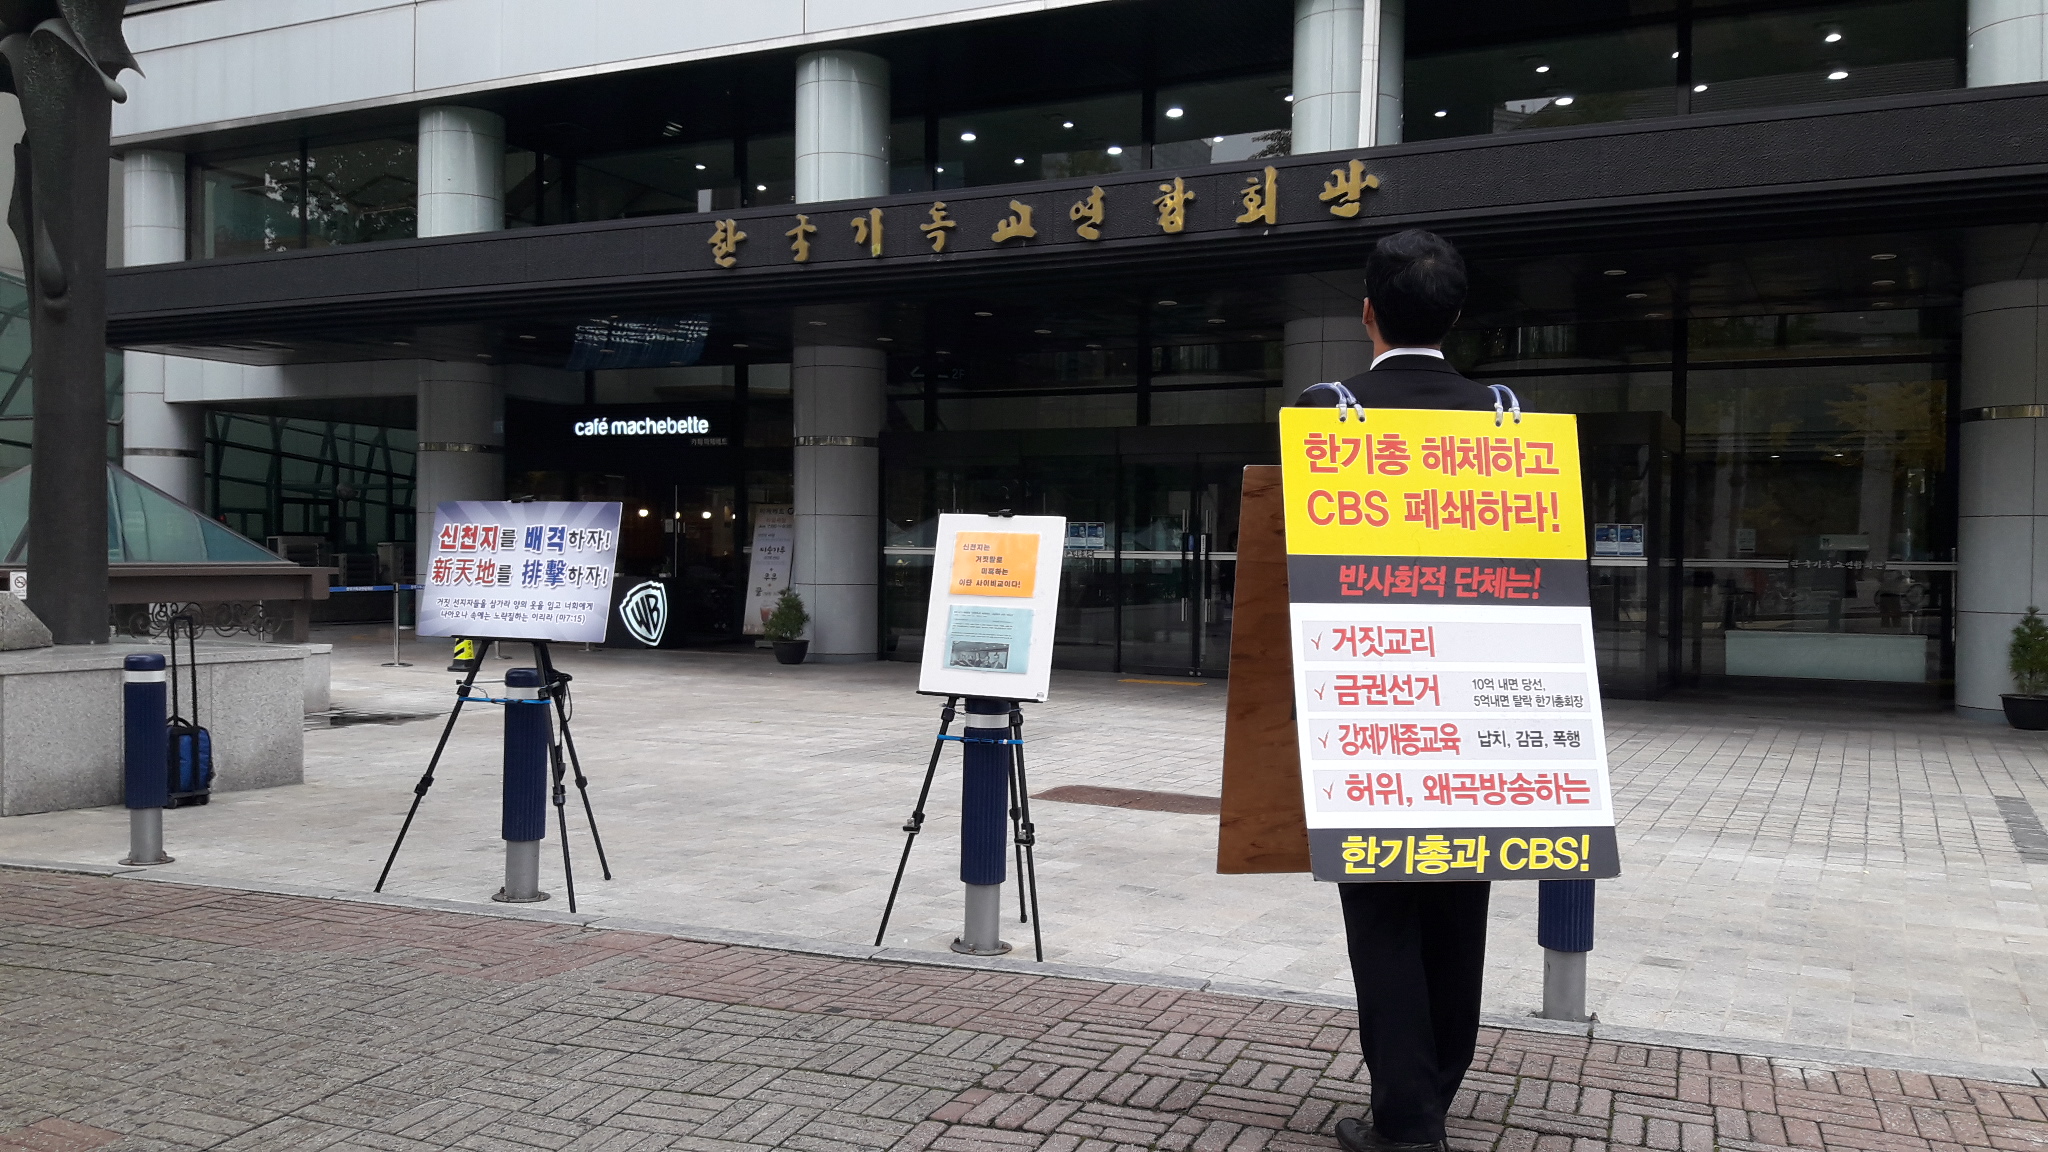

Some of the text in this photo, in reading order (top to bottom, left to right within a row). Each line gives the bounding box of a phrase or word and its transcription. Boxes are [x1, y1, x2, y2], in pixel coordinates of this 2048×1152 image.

[707, 158, 1380, 268] 한국기독교연합회관
[574, 416, 709, 436] café machebette
[1304, 433, 1560, 477] 한기총 해체하고
[1307, 489, 1560, 533] CBS 폐쇄하라!
[440, 525, 611, 552] 신천지를 배격하자!
[432, 558, 608, 586] 新天地를 排擊하자!
[976, 580, 1021, 588] 사이비교이다!
[1339, 564, 1541, 600] 반사회적 단체는!
[437, 598, 593, 611] 거짓 선지자들을 삼가라 양의 옷을 입고 너희에게
[441, 610, 586, 624] 나아오나 속에는 노략질하는 이리라 (마7:15)
[1332, 625, 1435, 657] 거짓교리
[1334, 674, 1441, 706] 금권선거
[1472, 678, 1546, 691] 10억 내면 당선,
[1474, 695, 1583, 708] 5억내면 탈락 한기총회장
[1338, 723, 1461, 756] 강제개종교육
[1477, 730, 1580, 748] 납치, 감금, 폭행
[1345, 772, 1591, 807] 허위, 왜곡방송하는
[1341, 834, 1590, 874] 한기총과 CBS!
